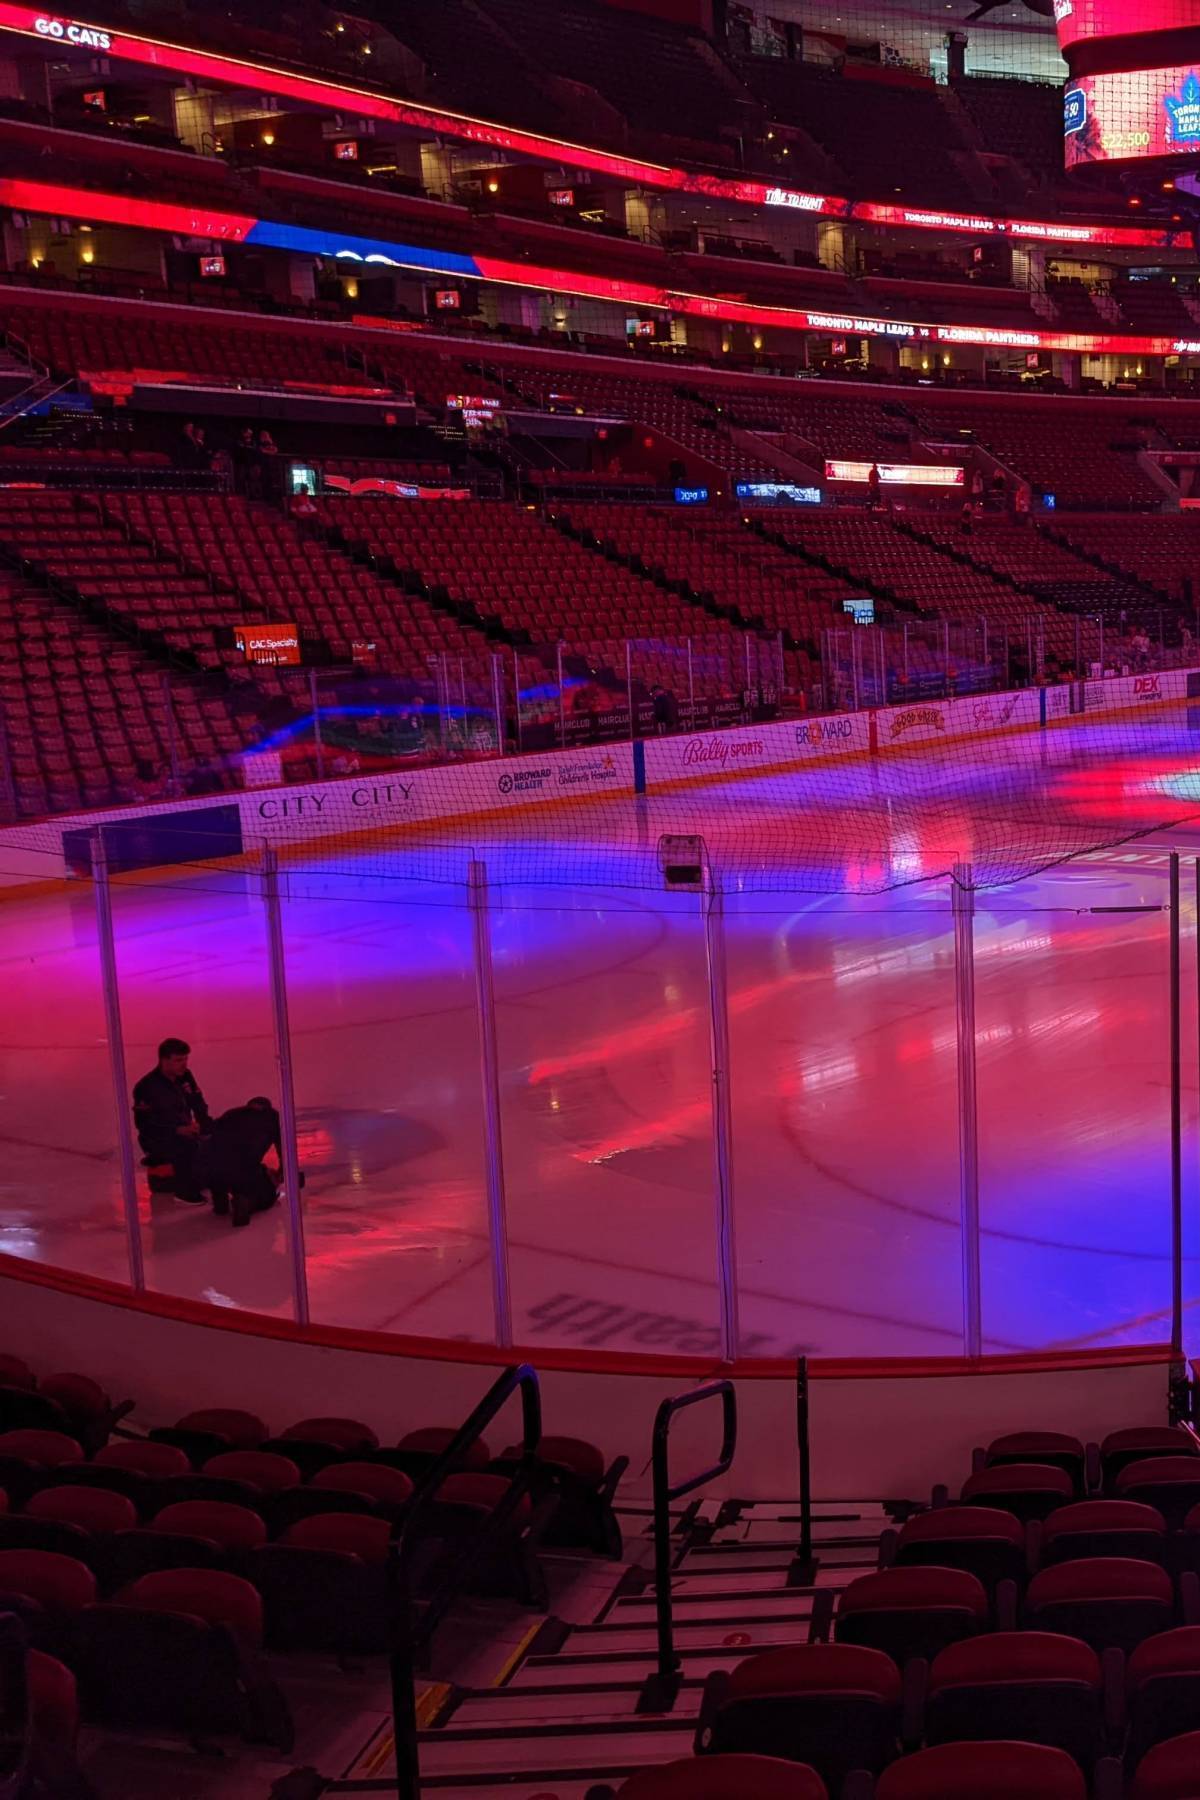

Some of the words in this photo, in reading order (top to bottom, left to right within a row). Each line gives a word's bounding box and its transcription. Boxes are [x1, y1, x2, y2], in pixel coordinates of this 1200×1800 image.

[35, 18, 63, 37] GO
[67, 26, 111, 49] CATS
[1102, 132, 1150, 149] $22,500
[904, 213, 942, 224] TORONTO
[943, 216, 969, 227] MAPLE
[970, 220, 994, 230] LEAFS
[1012, 224, 1046, 236] FLORIDA
[807, 315, 854, 329] TORONTO
[855, 320, 885, 333] MAPLE
[887, 325, 914, 336] LEAFS
[938, 329, 984, 342] FLORIDA
[985, 332, 1039, 345] PANTHERS
[249, 640, 266, 649] CAC
[267, 638, 298, 649] Specialty
[1134, 676, 1160, 694] DEX
[683, 737, 730, 768] Bally
[730, 740, 764, 757] SPORTS
[513, 768, 552, 781] BROWARD
[514, 780, 543, 791] HEALTH
[259, 793, 328, 819] CITY
[351, 782, 415, 807] CITY
